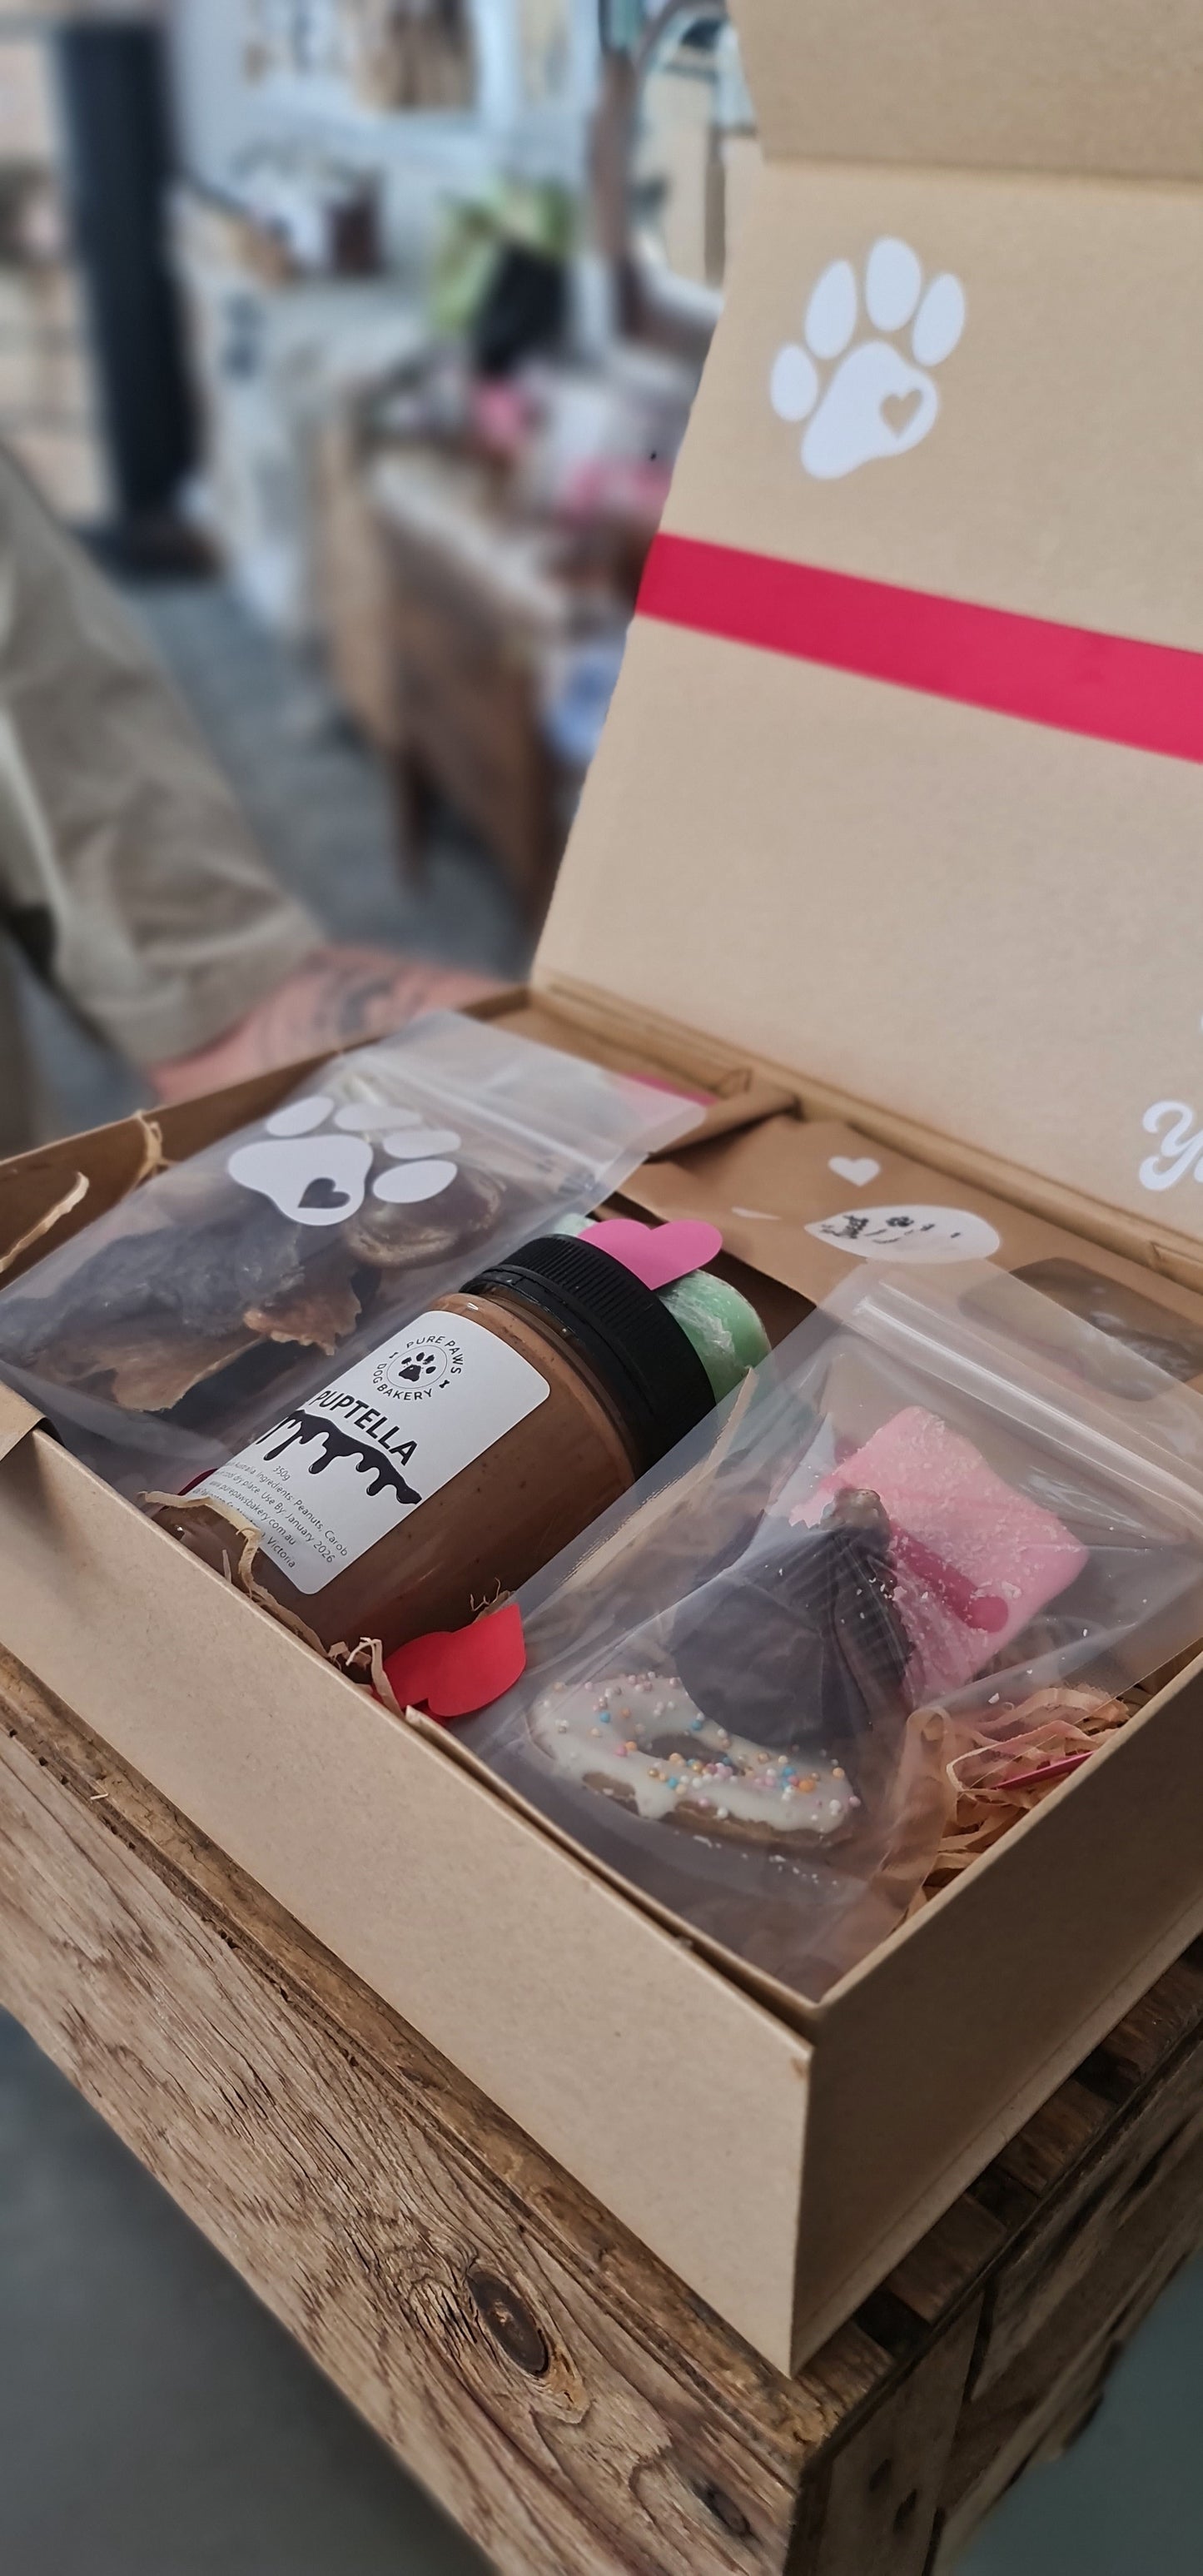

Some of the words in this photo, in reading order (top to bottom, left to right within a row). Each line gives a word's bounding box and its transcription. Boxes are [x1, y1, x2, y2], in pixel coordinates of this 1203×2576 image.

[406, 1335, 445, 1349] PURE
[445, 1340, 464, 1375] PAWS
[372, 1363, 387, 1384] DOG
[376, 1383, 432, 1400] BAKERY
[308, 1390, 418, 1466] PUPTELLA
[272, 1465, 291, 1482] 350g
[261, 1491, 276, 1505] Use
[285, 1512, 315, 1543] January
[313, 1540, 336, 1564] 2026
[293, 1499, 323, 1532] Peanuts,
[325, 1529, 348, 1557] Carob
[266, 1536, 296, 1569] Victoria
